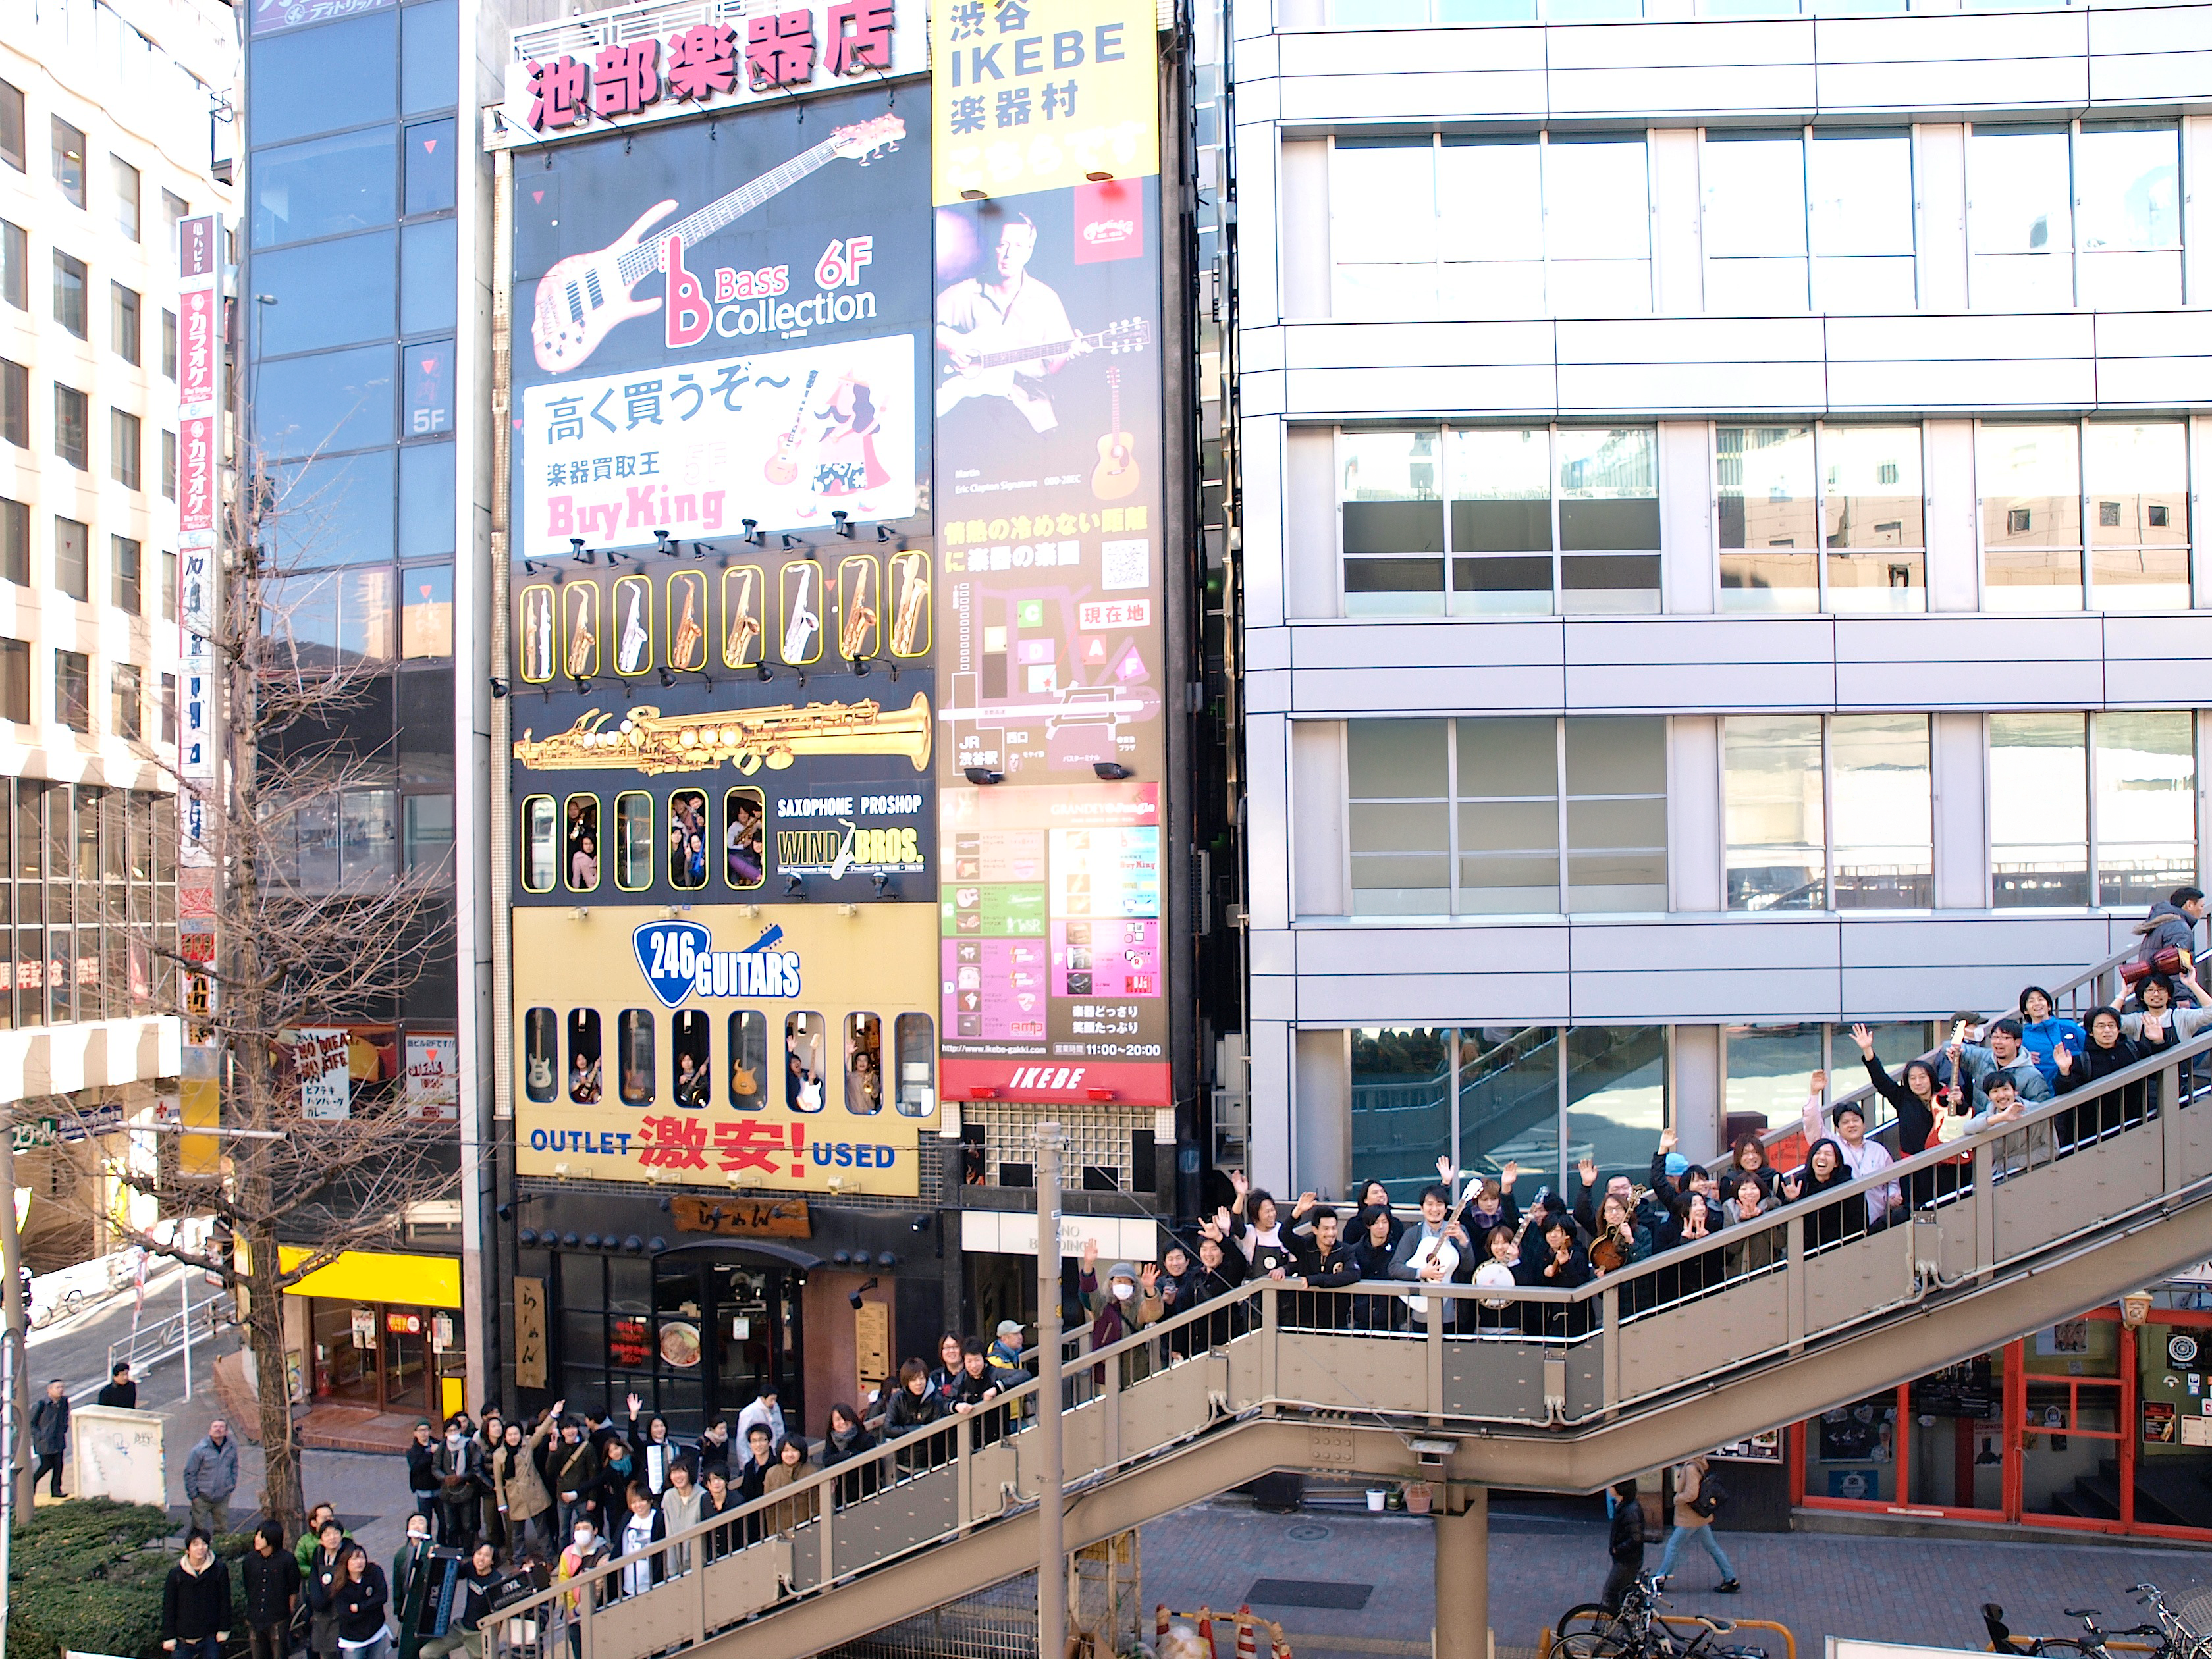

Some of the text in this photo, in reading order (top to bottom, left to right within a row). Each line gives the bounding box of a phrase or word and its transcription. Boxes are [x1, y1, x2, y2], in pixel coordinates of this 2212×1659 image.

[950, 0, 1031, 42] 渋谷
[527, 0, 894, 131] 池部楽器店
[952, 22, 1125, 88] IKEBE
[950, 79, 1079, 135] 楽器村
[946, 120, 1146, 189] こちらです
[715, 236, 873, 303] Bass 6F
[715, 290, 877, 338] Collection
[188, 312, 207, 387] カラオケ
[413, 408, 445, 433] 5F
[188, 439, 207, 514] カラオケ
[547, 451, 659, 487] 楽器買取王
[955, 469, 980, 478] Martin
[955, 485, 969, 494] Eric
[969, 483, 1000, 493] Clapton
[1000, 480, 1037, 491] Signature
[547, 484, 726, 541] BuyKing
[944, 505, 1148, 546] 情熱の冷めない距離
[1025, 605, 1039, 622] C
[1085, 605, 1144, 624] 現在地
[1029, 643, 1044, 660] D
[1089, 639, 1104, 657] A
[1125, 658, 1139, 675] F
[959, 735, 980, 749] JR
[1006, 732, 1028, 744] 西口
[959, 750, 998, 766] 渋谷駅
[778, 794, 922, 818] SAXOPHONE PROSHOP
[777, 827, 925, 865] WIND BROS.
[650, 930, 801, 998] 246 GUITARS
[1073, 1005, 1139, 1018] 楽器どっさり
[1073, 1021, 1139, 1034] 笑顔たっぷり
[941, 1043, 1046, 1055] http://www.ikebe-gakki.com
[1009, 1066, 1086, 1089] IKEBE
[307, 1108, 327, 1117] カレー
[531, 1129, 632, 1155] OUTLET
[637, 1115, 805, 1178] 激安!
[813, 1142, 896, 1169] USED
[698, 1199, 770, 1230] らーめん
